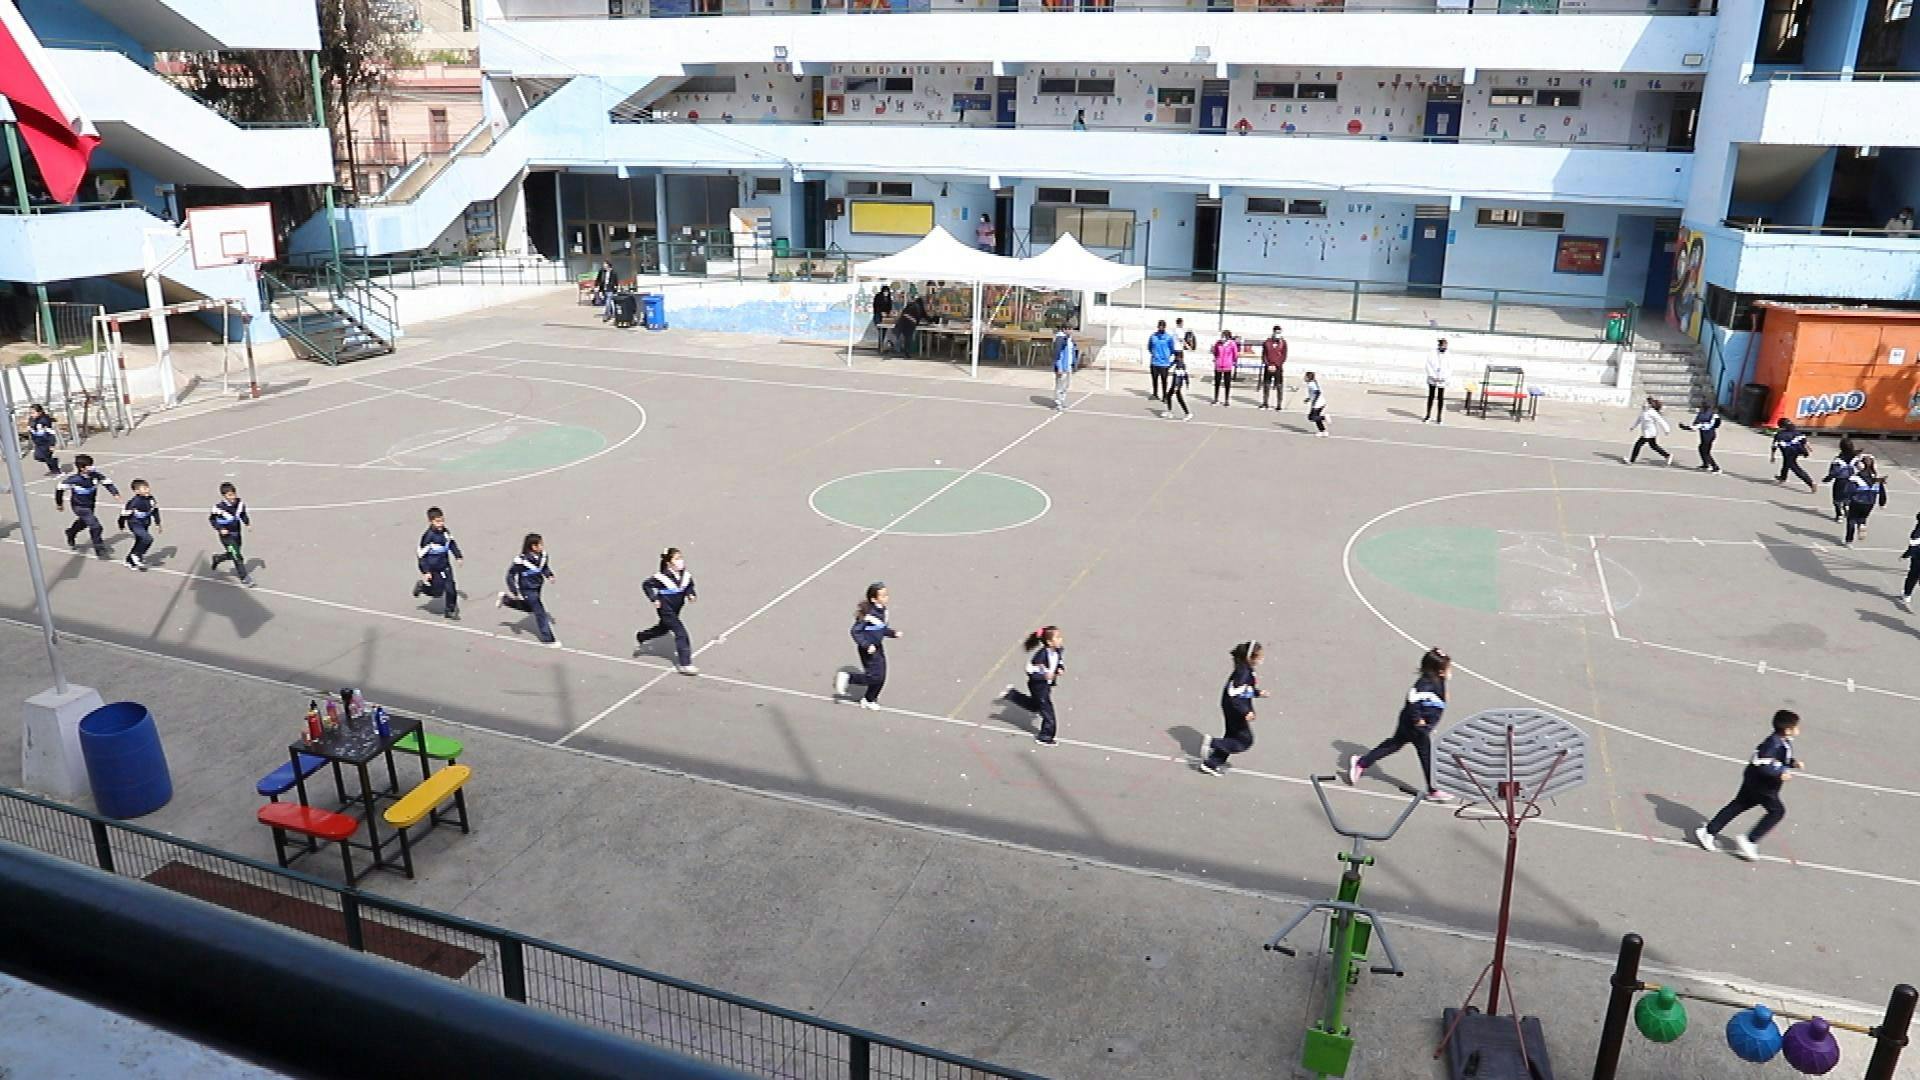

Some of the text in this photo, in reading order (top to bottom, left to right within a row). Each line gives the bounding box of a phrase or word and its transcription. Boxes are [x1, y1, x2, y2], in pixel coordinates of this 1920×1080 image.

[1547, 77, 1560, 87] 13
[1647, 79, 1662, 89] 16
[1348, 204, 1372, 213] UTP
[1797, 391, 1866, 419] KAPO
